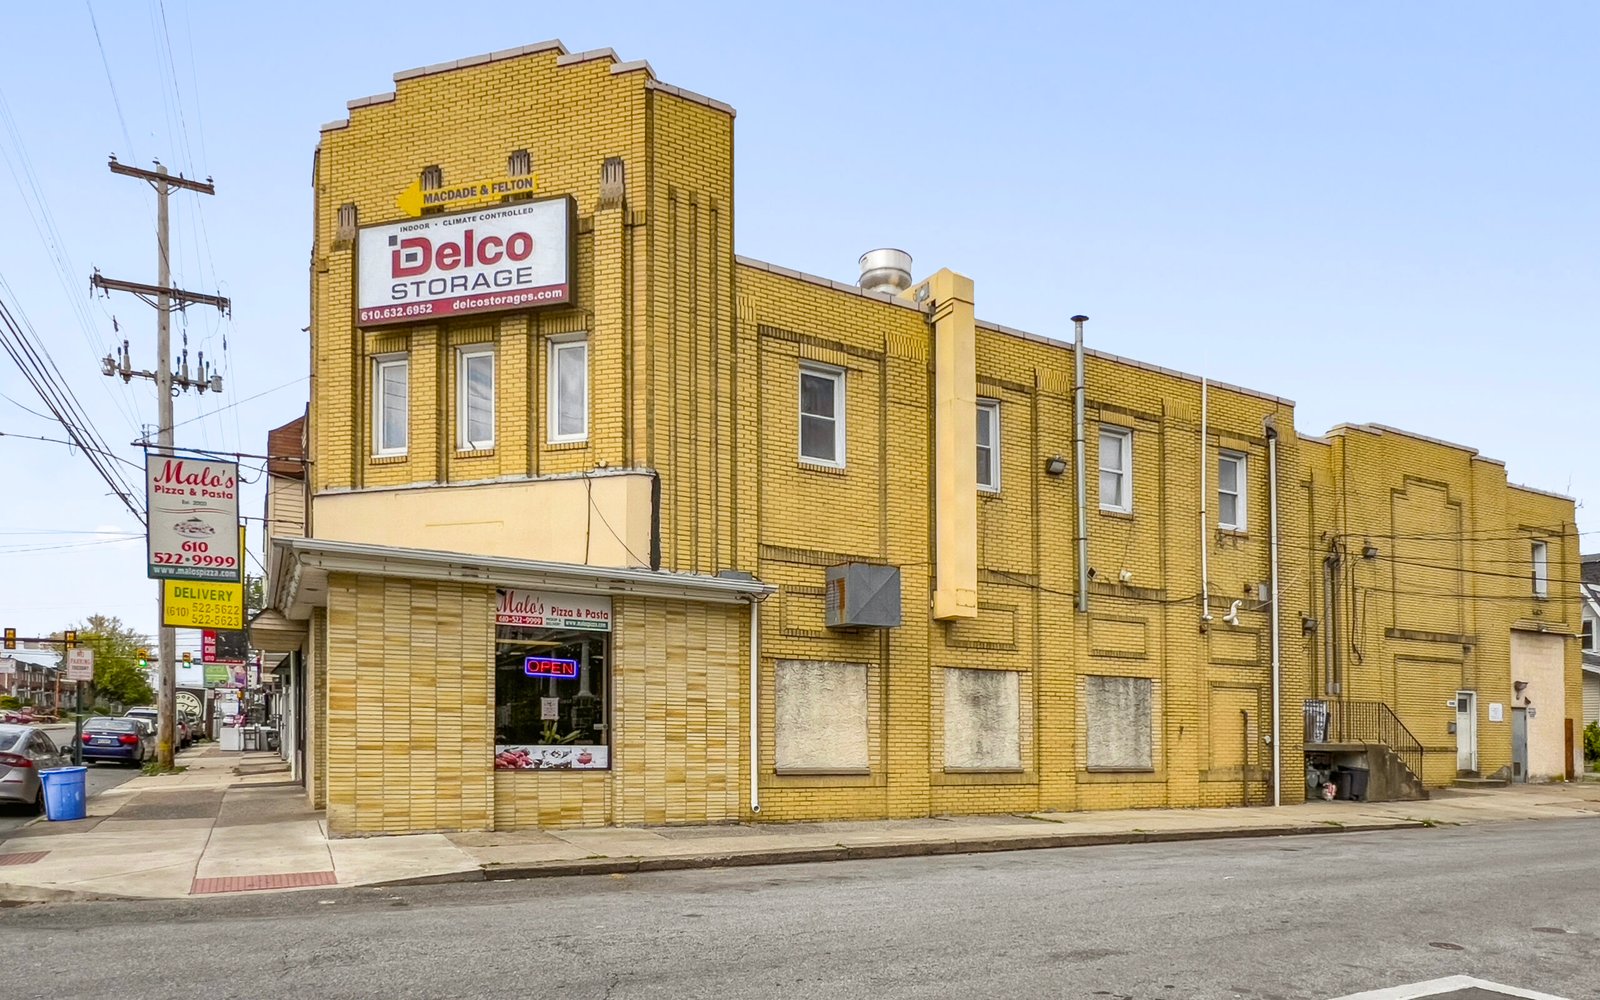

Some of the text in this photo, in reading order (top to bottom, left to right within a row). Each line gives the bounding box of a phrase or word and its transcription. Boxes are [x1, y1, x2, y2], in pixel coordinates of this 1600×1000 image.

[424, 177, 533, 204] MACDADE & FELTON
[400, 207, 534, 233] INDOOR CLIMATE CONTROLLED
[392, 267, 533, 301] STORAGE
[361, 289, 562, 321] 610.632.6952 delcostorages.com
[153, 459, 234, 489] Malo's
[154, 485, 233, 500] Pizza & Pasta
[181, 541, 208, 553] 610
[153, 567, 237, 577] www.malospizza.com
[174, 587, 233, 602] DELIVERY
[192, 602, 240, 615] 522-5622
[496, 589, 544, 615] Malo's
[166, 606, 190, 617] (610)
[551, 606, 609, 620] Pizza & Pasta
[192, 615, 240, 626] 522-5623
[498, 615, 542, 625] 610-522-9999
[527, 660, 574, 674] OPEN
